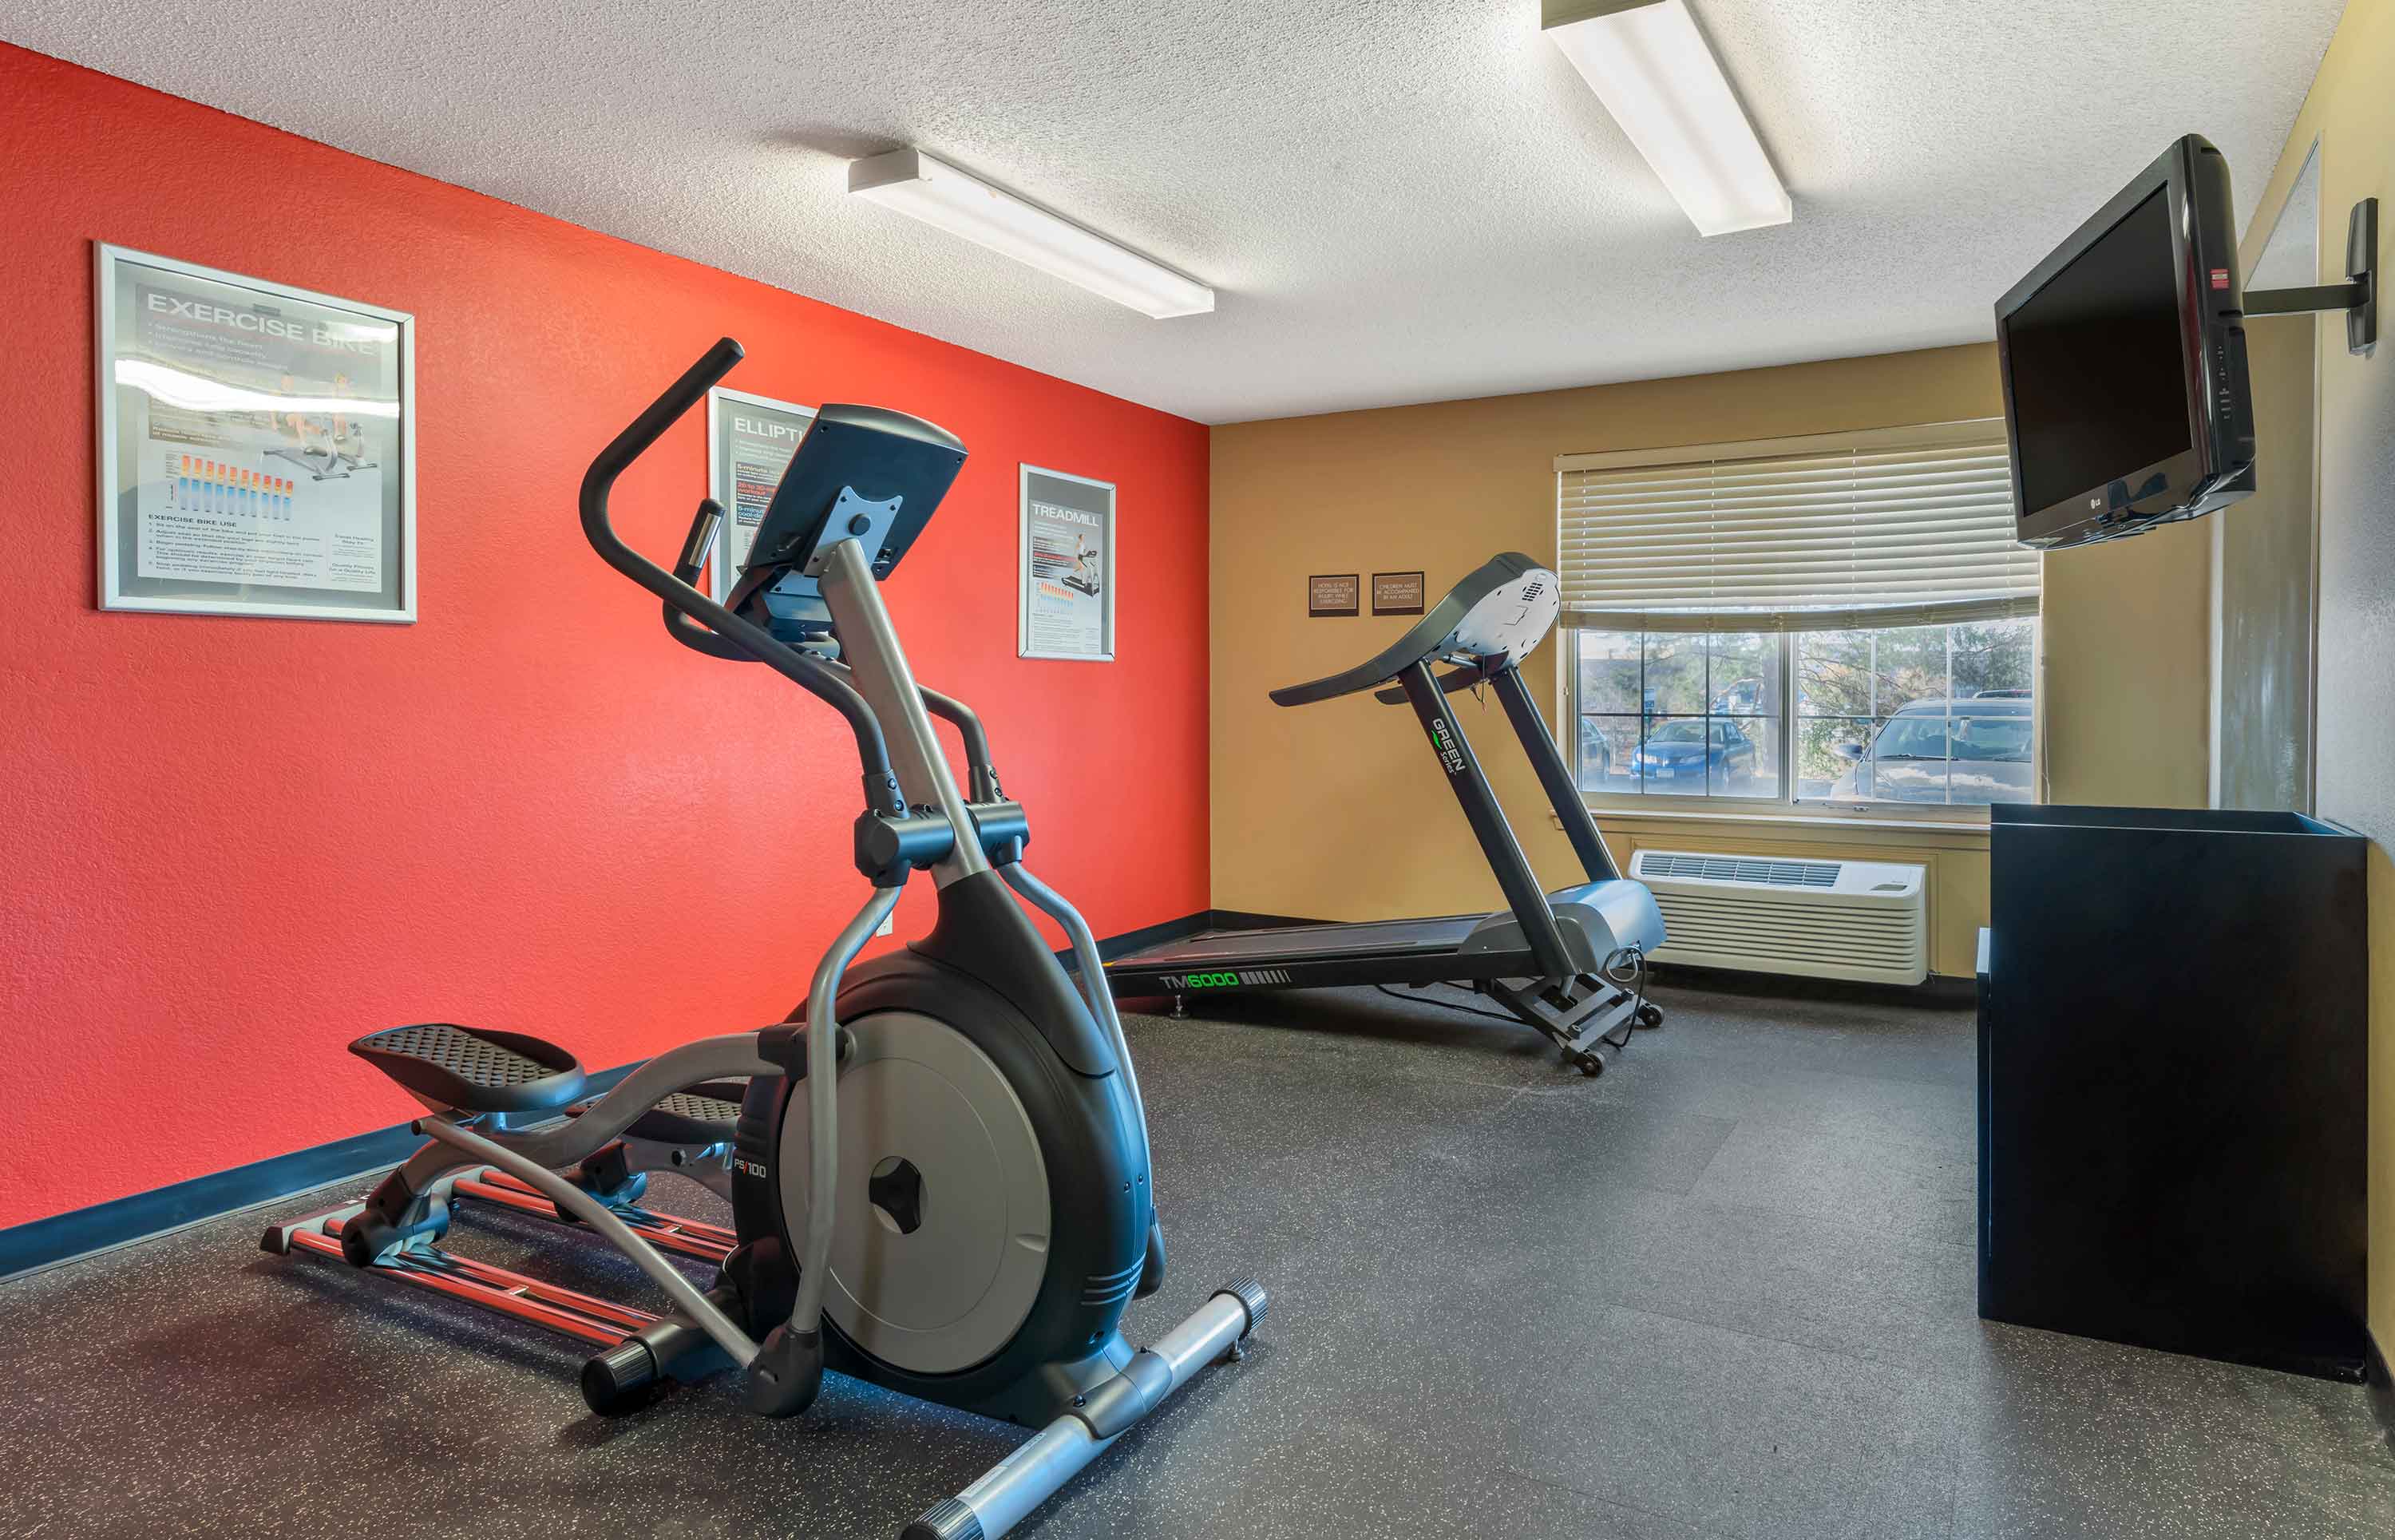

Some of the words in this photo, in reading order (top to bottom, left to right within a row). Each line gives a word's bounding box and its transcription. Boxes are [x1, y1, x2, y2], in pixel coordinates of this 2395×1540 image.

[148, 292, 305, 341] EXERCISE
[312, 327, 375, 355] BIKE
[148, 513, 195, 524] EXERCISE
[1032, 504, 1099, 527] TREADMILL
[1432, 718, 1466, 770] GREEN
[1439, 751, 1455, 774] Series
[1158, 972, 1241, 990] TM6000
[734, 1158, 767, 1178] PS/100
